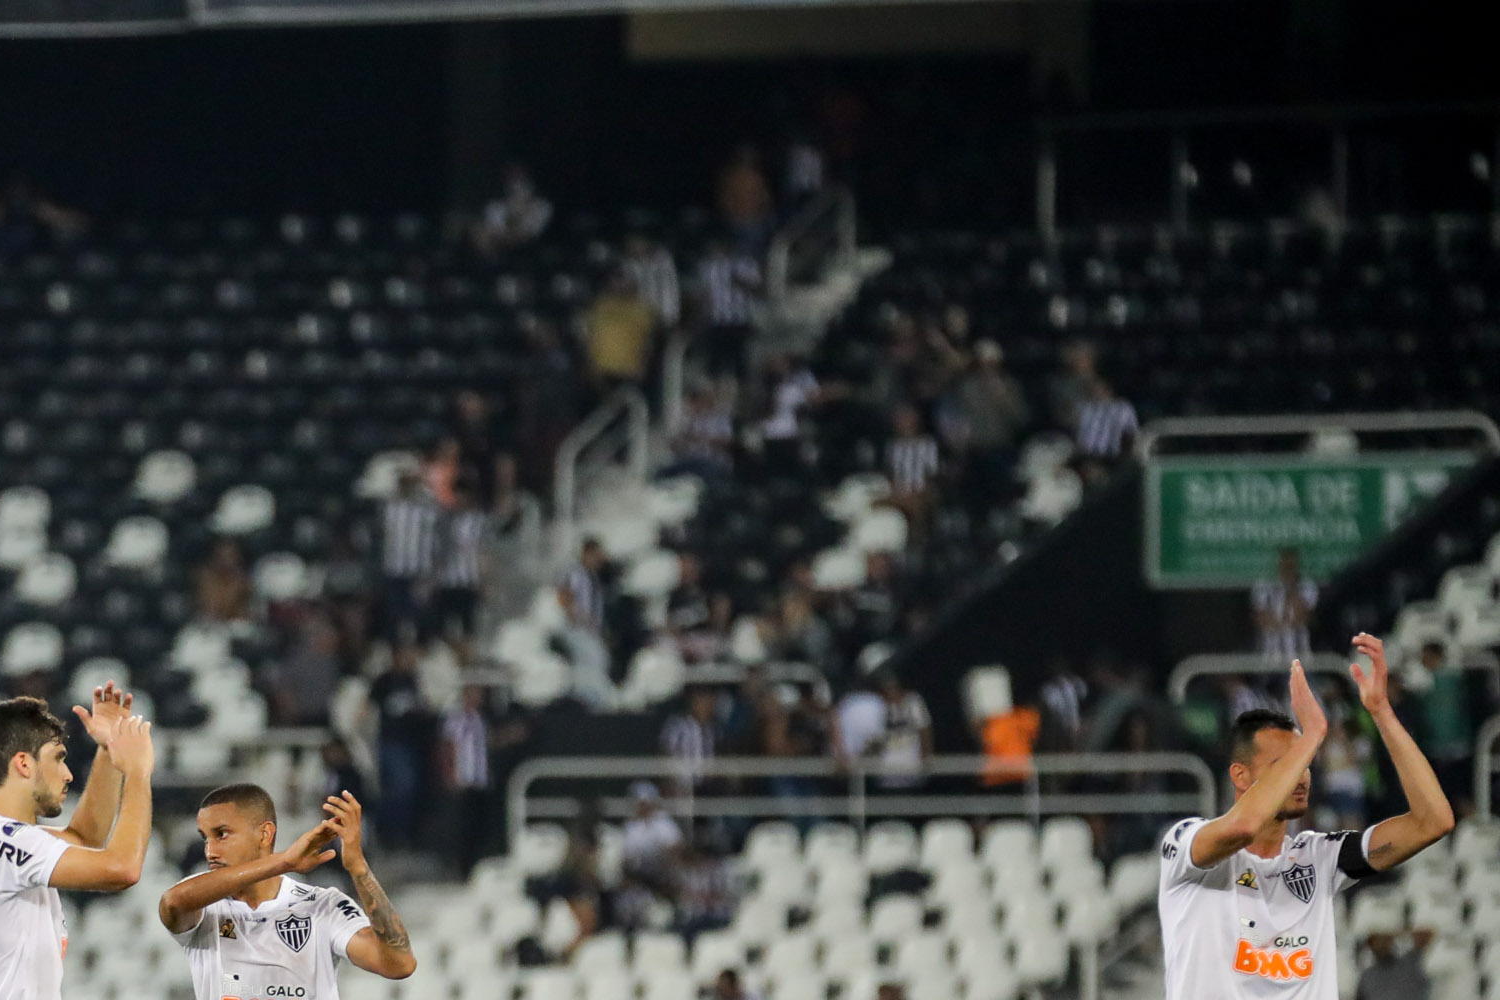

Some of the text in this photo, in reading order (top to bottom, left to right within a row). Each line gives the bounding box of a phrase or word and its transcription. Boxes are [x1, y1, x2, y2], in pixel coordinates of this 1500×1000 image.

[280, 920, 307, 930] CAM
[1274, 936, 1309, 948] GALO
[1233, 938, 1314, 981] BMG
[266, 985, 306, 998] GALO
